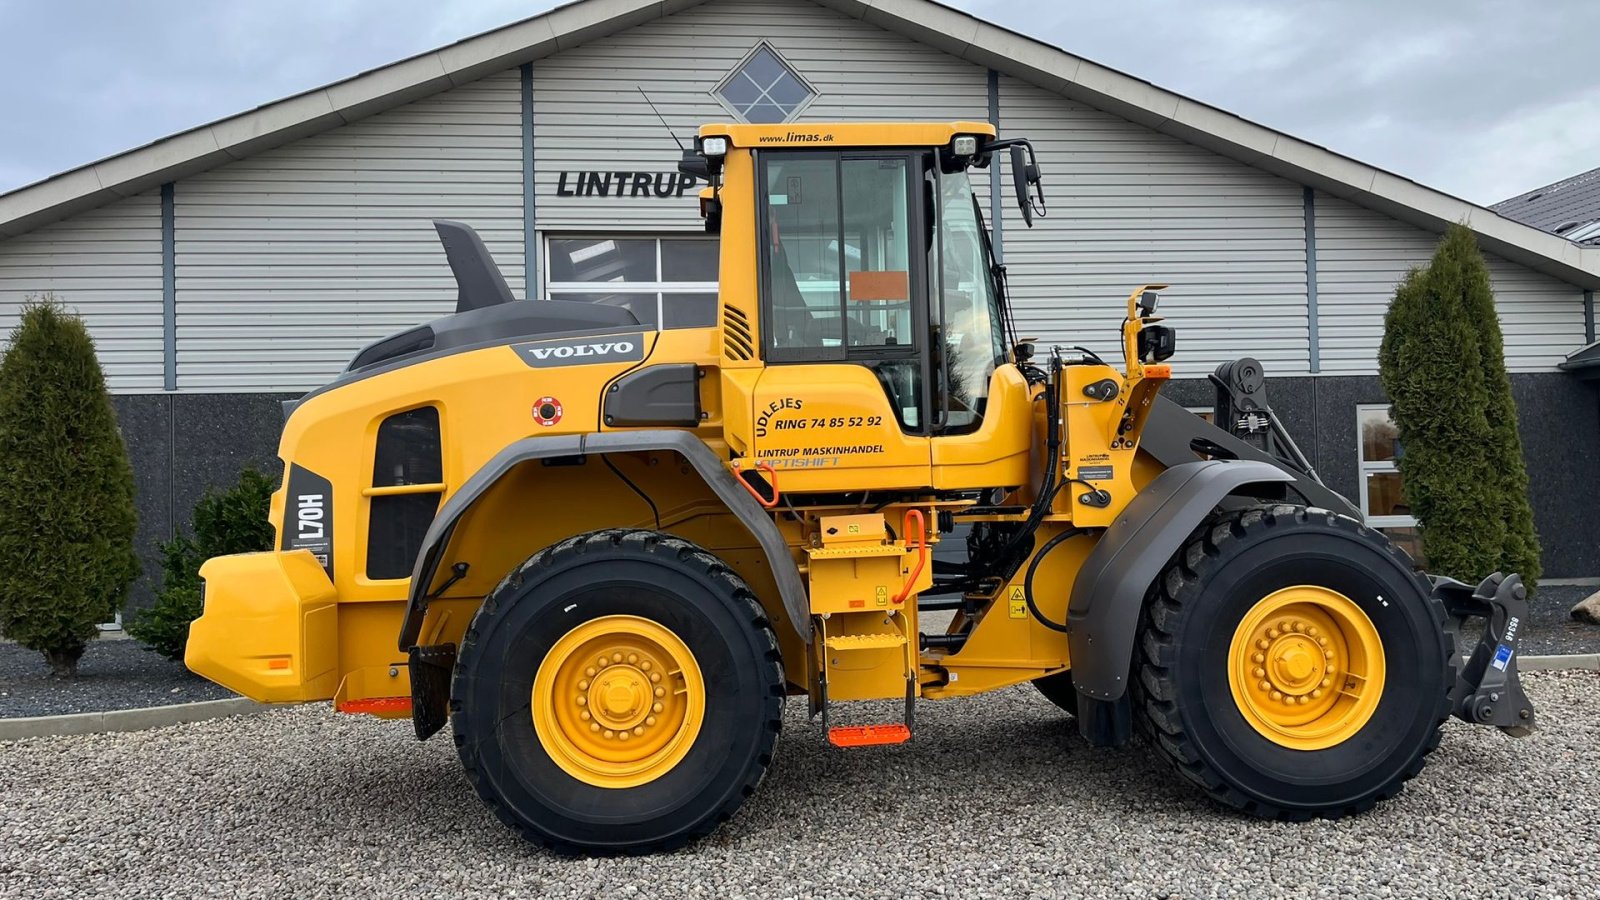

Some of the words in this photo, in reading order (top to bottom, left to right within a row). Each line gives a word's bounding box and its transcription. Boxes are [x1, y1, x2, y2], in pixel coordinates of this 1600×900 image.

[759, 132, 834, 143] www.limas.dk
[556, 171, 697, 198] LINTRUP
[529, 341, 634, 360] VOLVO
[756, 397, 803, 437] UDLEJES
[775, 419, 807, 430] RING
[811, 418, 825, 429] 74
[829, 417, 844, 428] 85
[848, 416, 863, 427] 52
[867, 416, 882, 426] 92
[758, 448, 800, 458] LINTRUP
[802, 445, 885, 456] MASKINHANDEL
[298, 494, 324, 539] L70H
